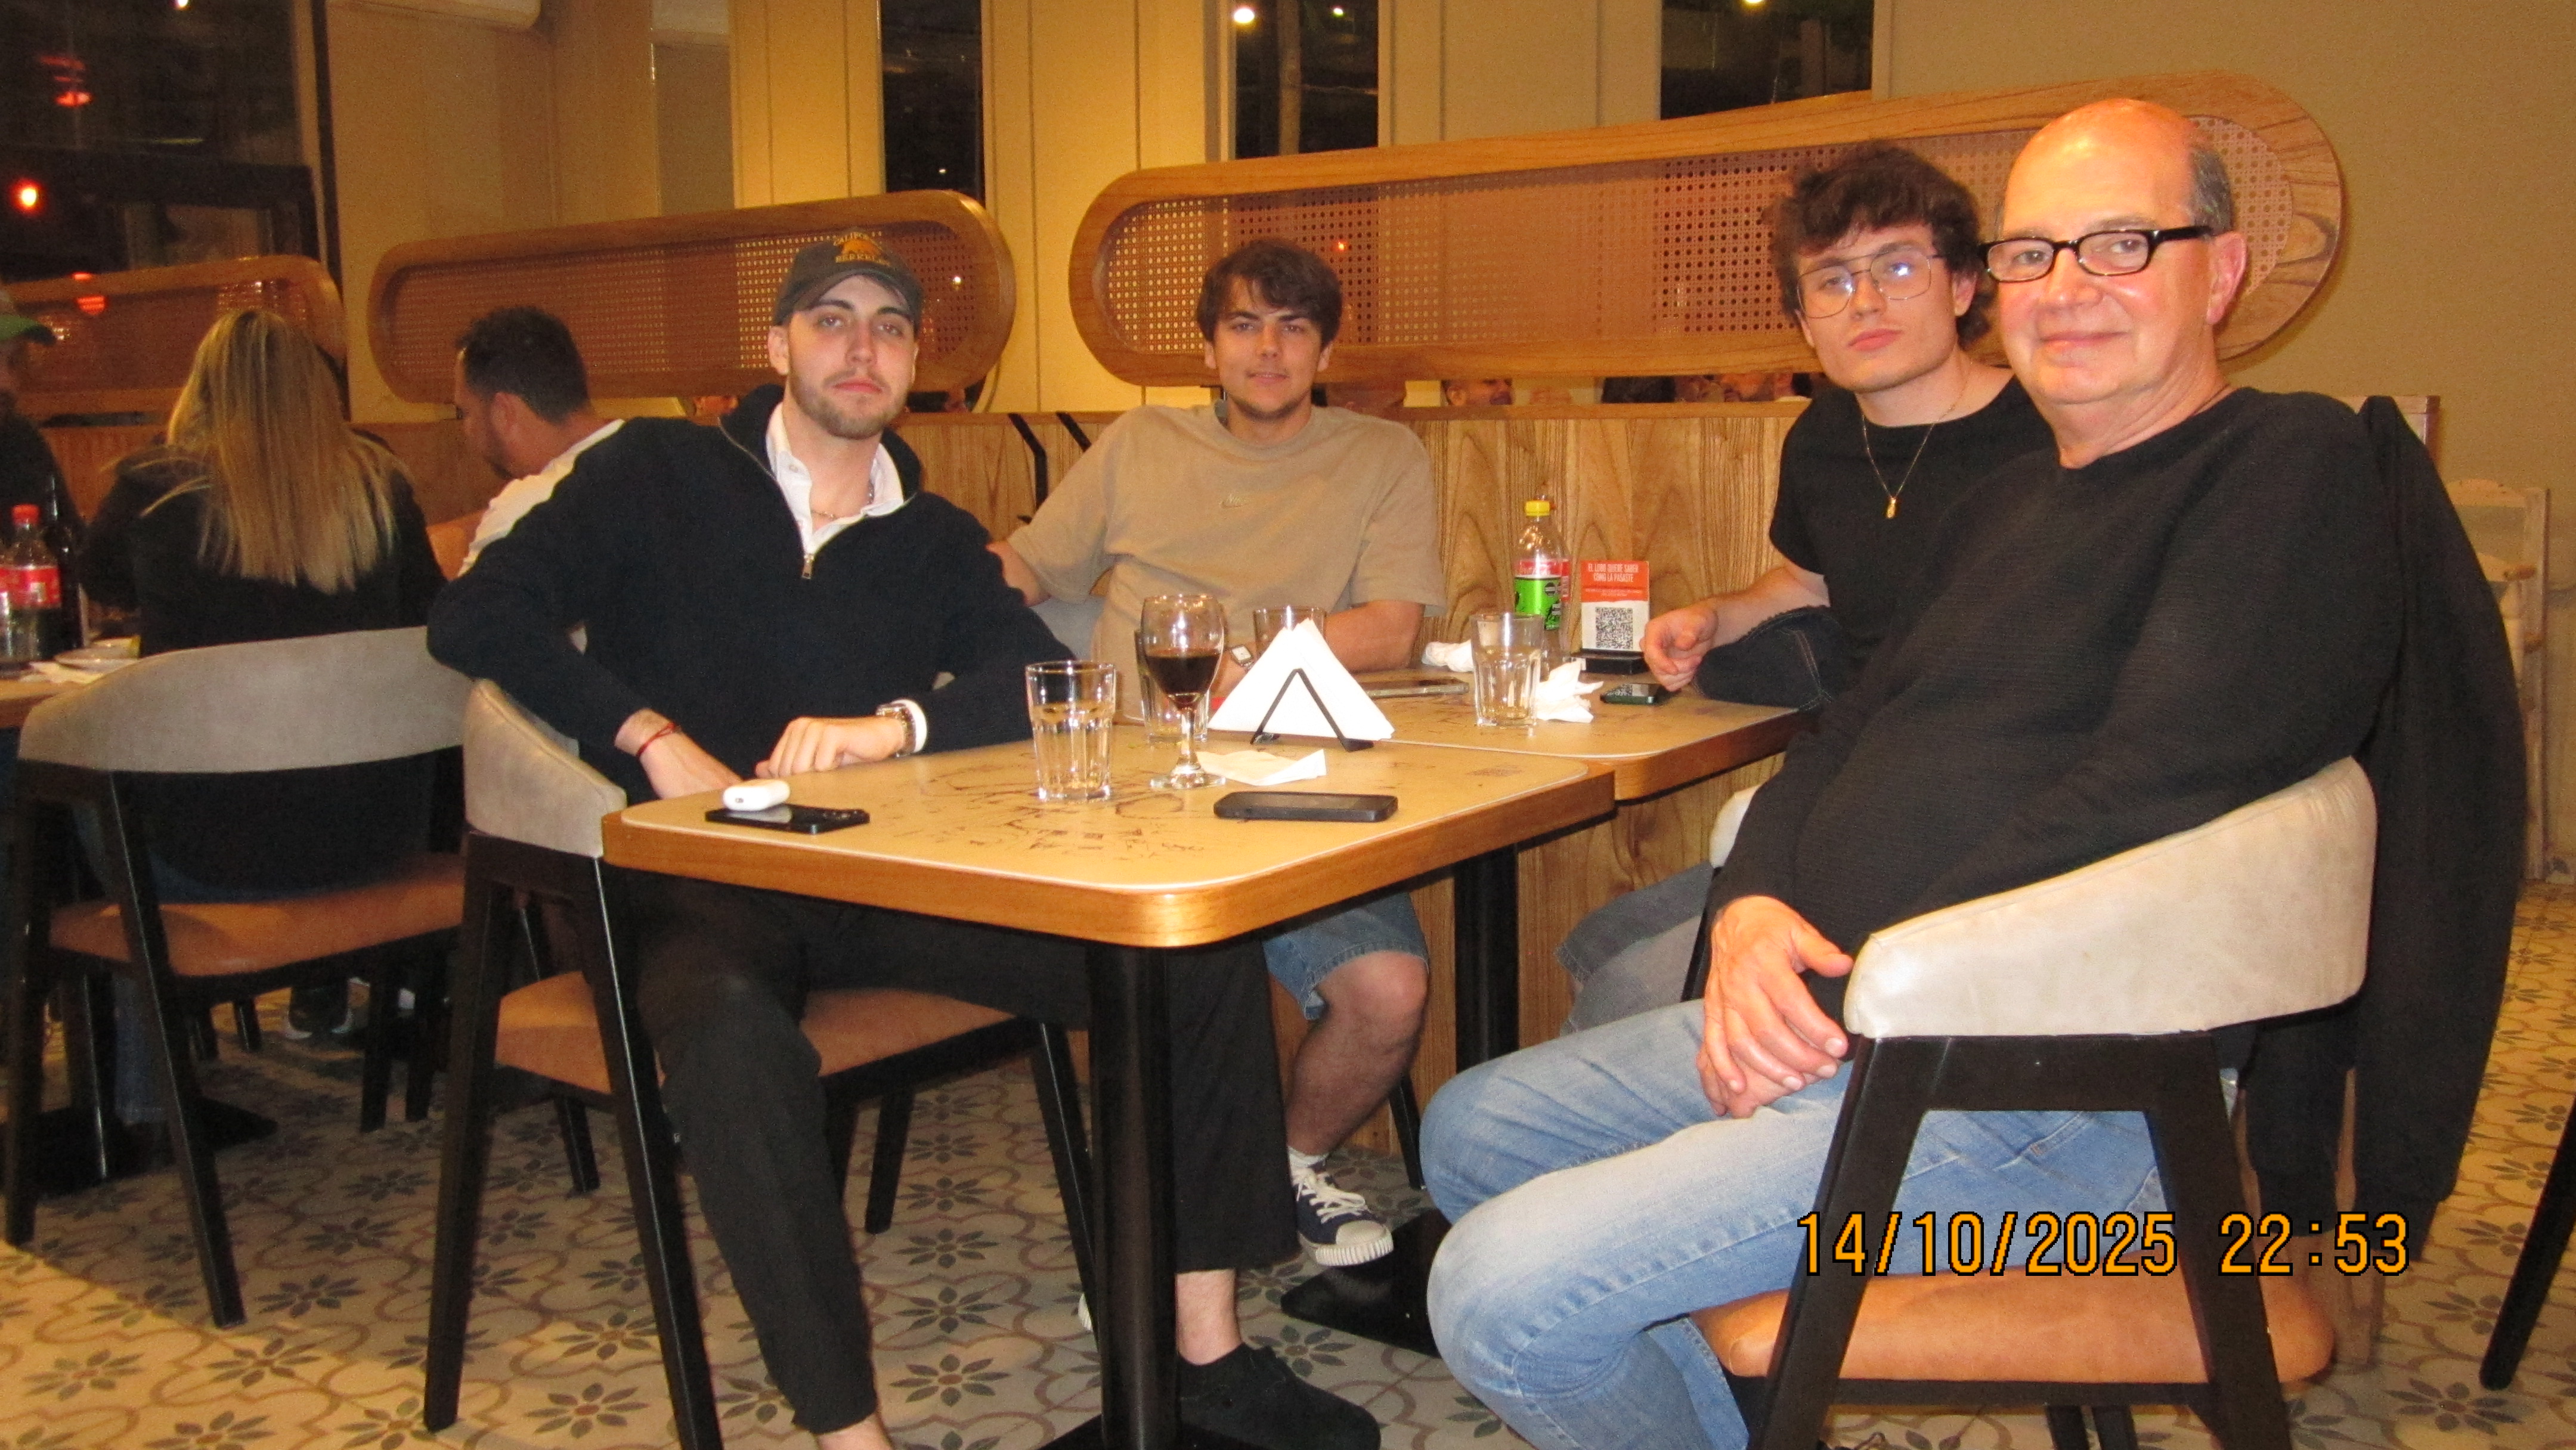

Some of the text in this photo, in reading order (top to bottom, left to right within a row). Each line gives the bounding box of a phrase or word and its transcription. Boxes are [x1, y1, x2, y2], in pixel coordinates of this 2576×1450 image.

[1589, 563, 1594, 572] EL
[1594, 563, 1606, 572] LOBO
[1624, 564, 1639, 573] SABER
[1607, 573, 1614, 581] LA
[1614, 573, 1634, 583] PASASTE
